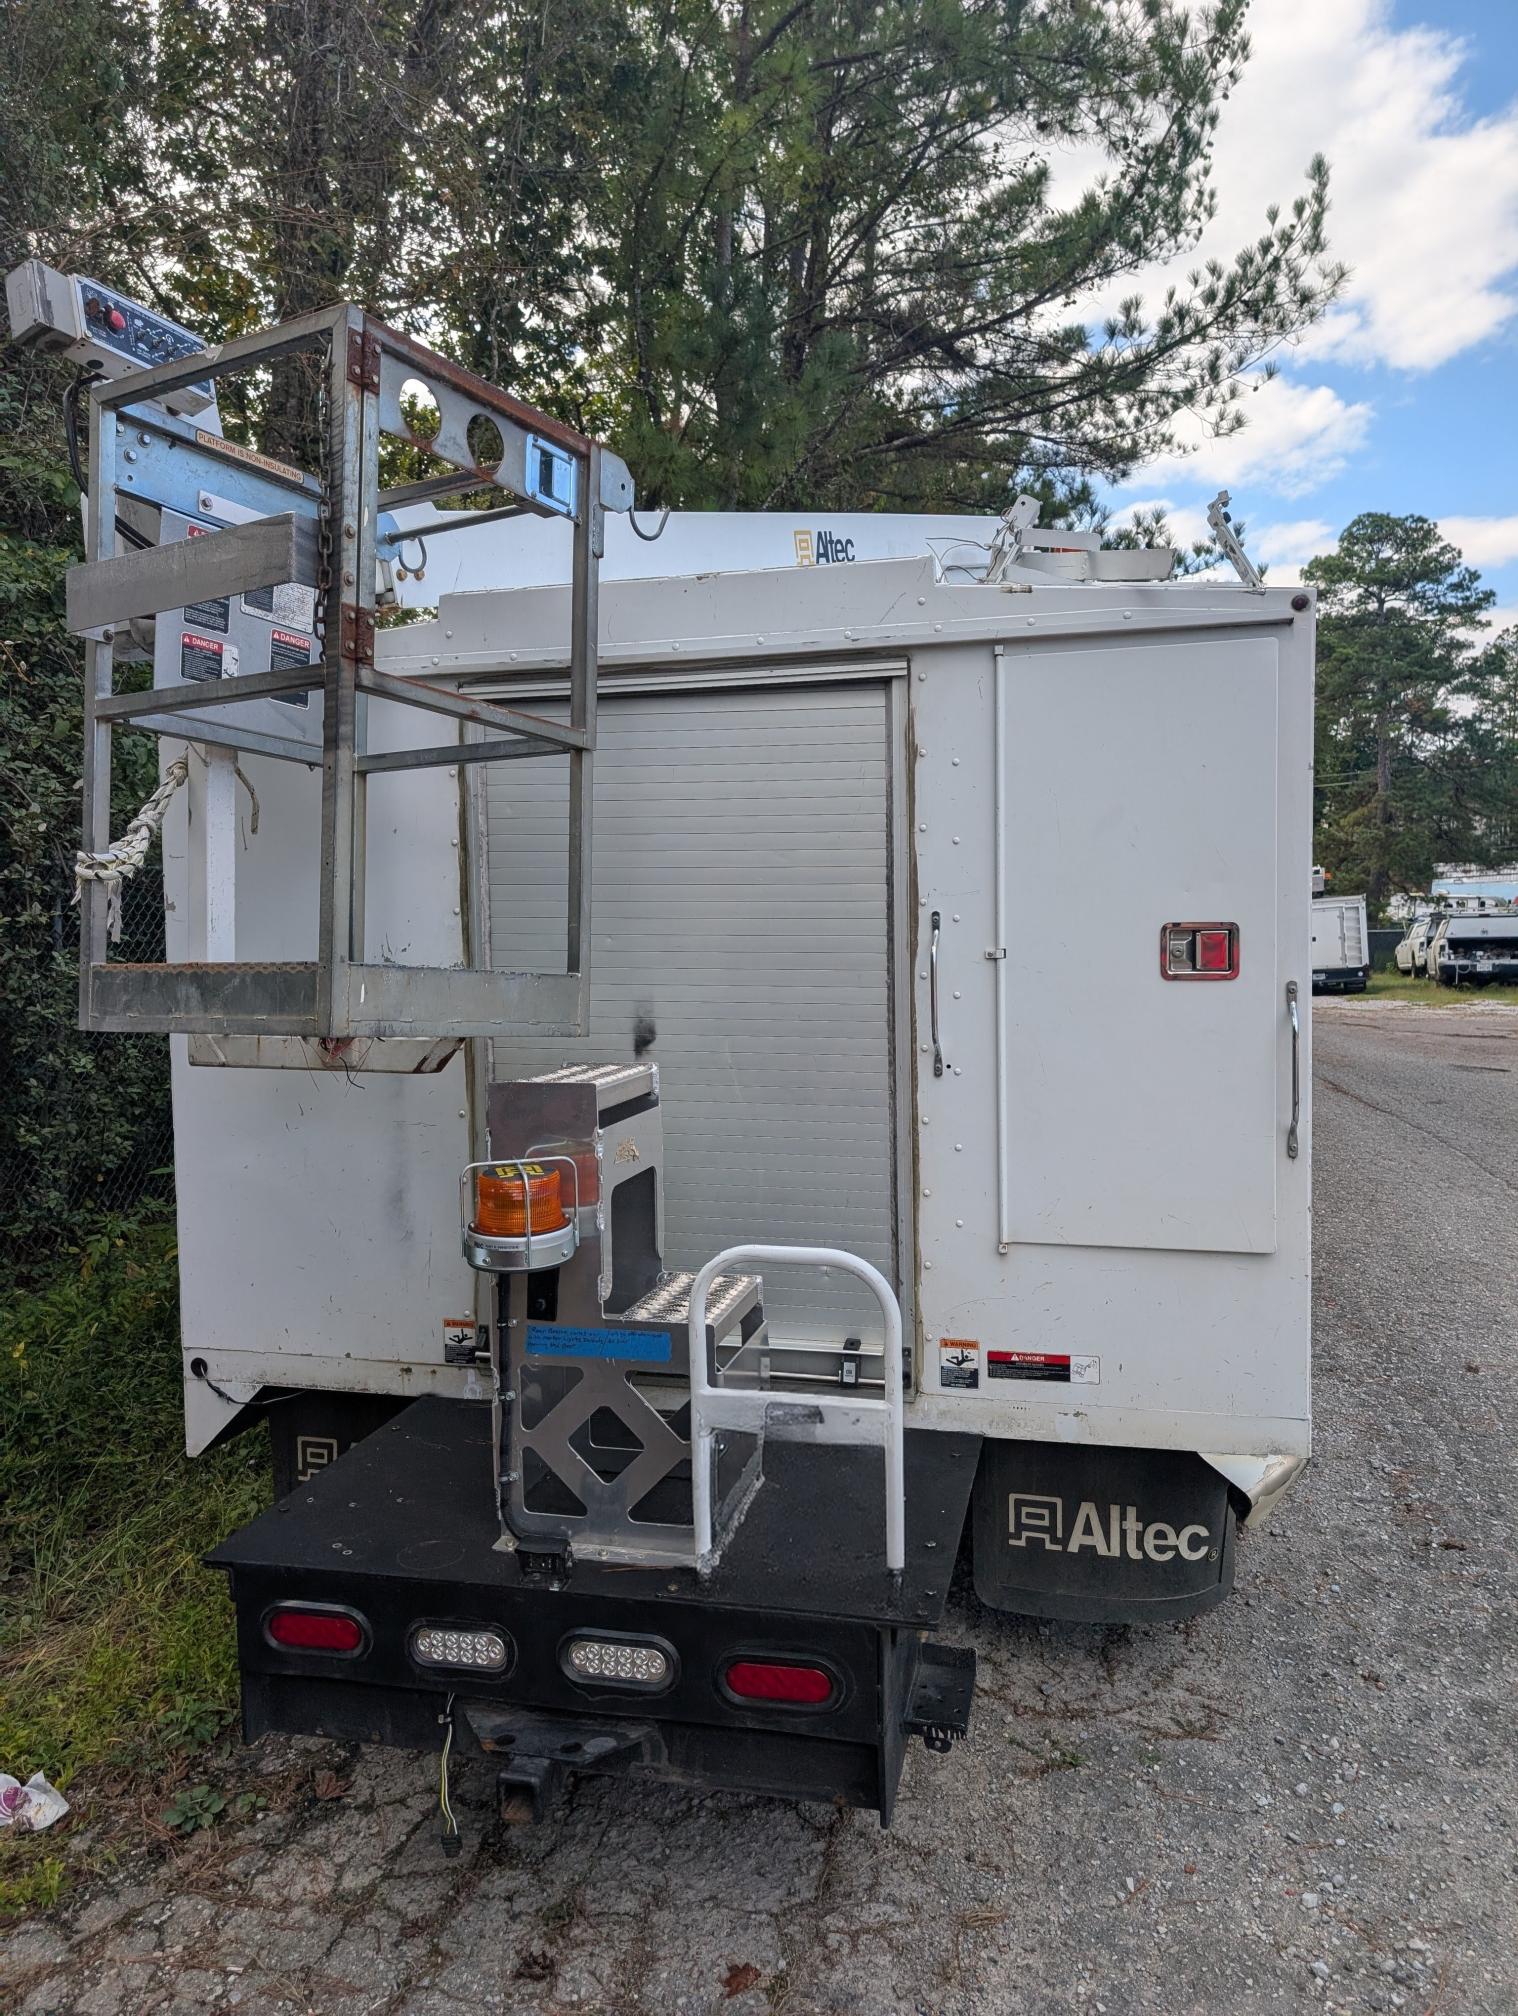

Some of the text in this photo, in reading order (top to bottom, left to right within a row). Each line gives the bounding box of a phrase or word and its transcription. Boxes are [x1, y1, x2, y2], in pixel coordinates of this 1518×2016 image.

[198, 432, 302, 481] PLATFORM IS NON-INSULATING
[816, 530, 855, 564] Altec
[192, 637, 219, 650] DANGER
[280, 633, 310, 649] DANGER
[950, 1340, 977, 1348] WARNING
[1066, 1501, 1210, 1562] Altec
